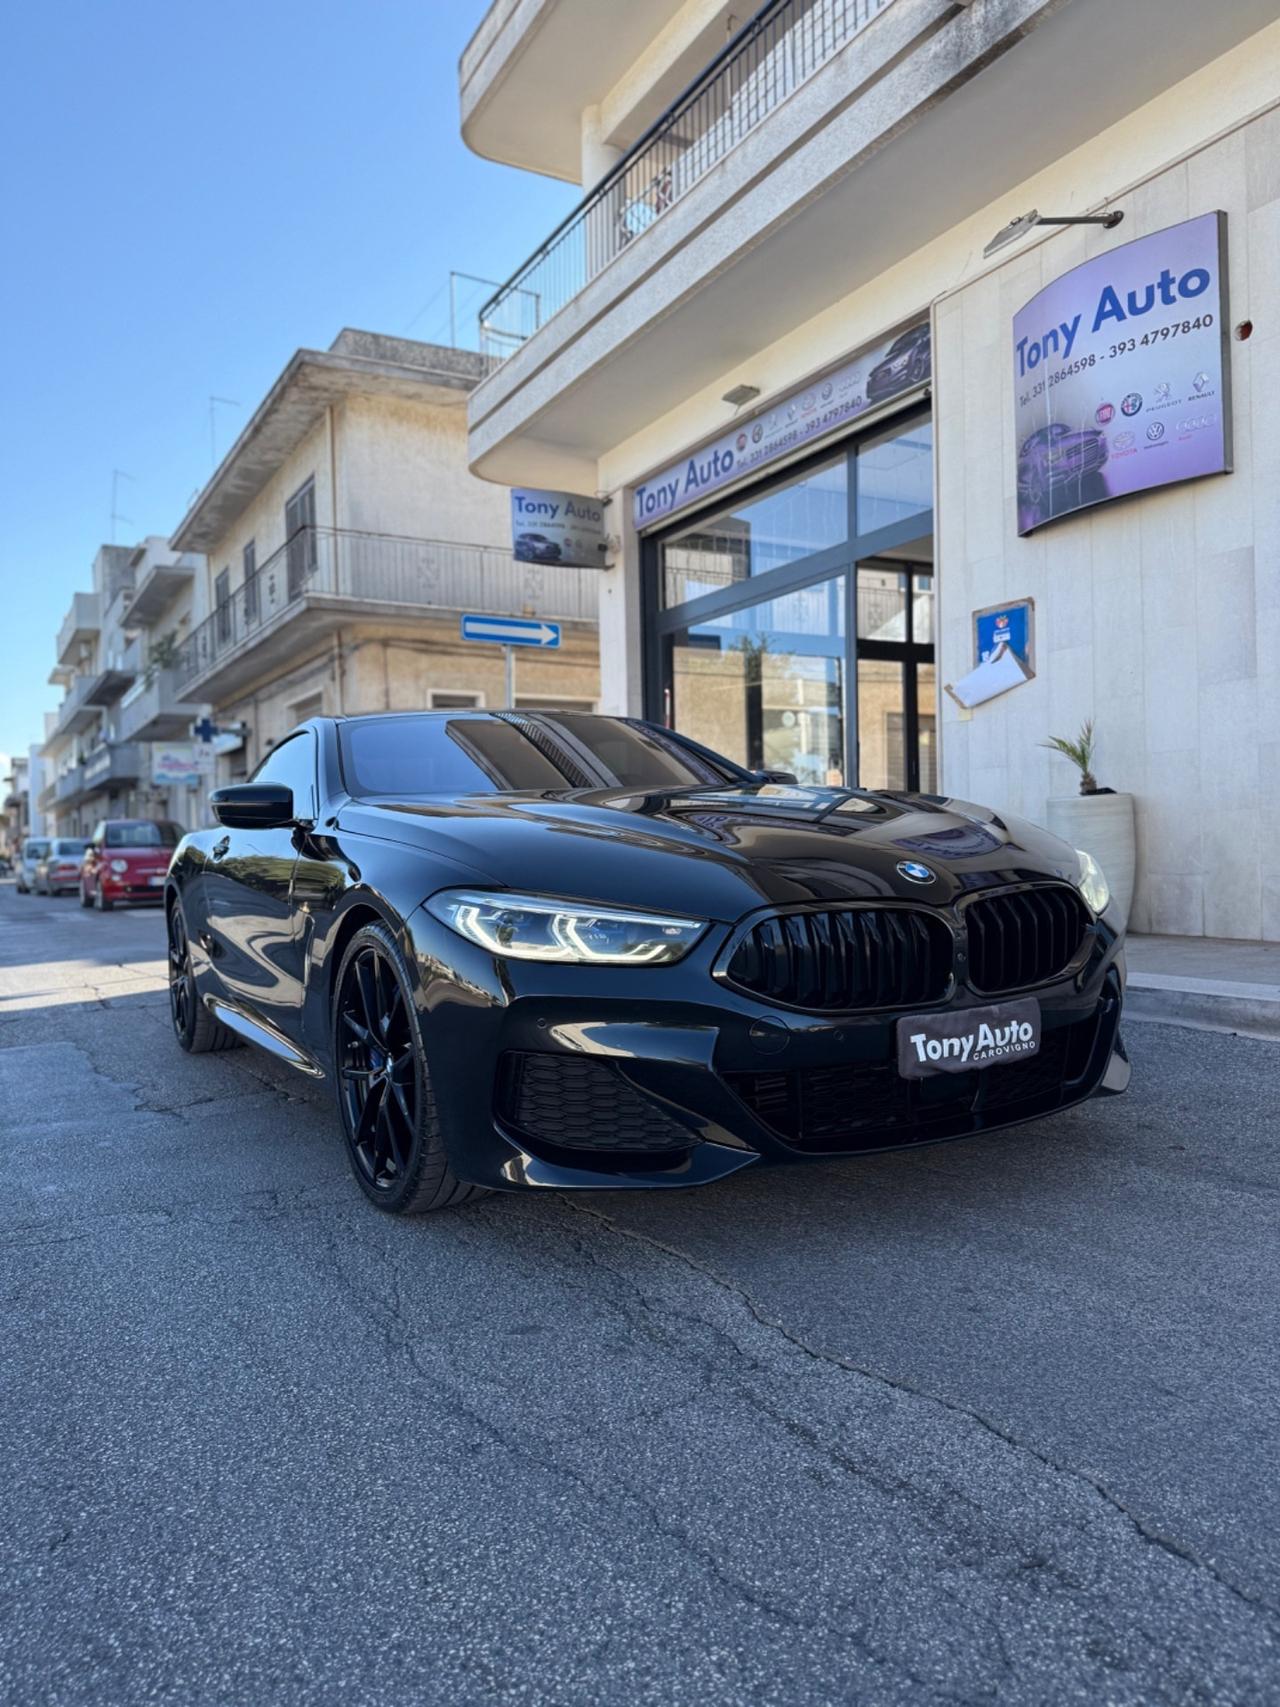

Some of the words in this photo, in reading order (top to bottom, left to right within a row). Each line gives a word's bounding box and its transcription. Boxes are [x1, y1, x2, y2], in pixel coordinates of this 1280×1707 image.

[1016, 314, 1082, 377] Tony
[1091, 268, 1211, 333] Auto
[1032, 381, 1046, 398] 331
[1047, 354, 1096, 388] 2864598
[1109, 338, 1136, 359] 393
[1140, 314, 1213, 346] 4797840
[514, 495, 560, 520] Tony
[564, 500, 602, 522] Auto
[636, 478, 680, 517] Tony
[684, 449, 734, 494] Auto
[973, 1040, 1036, 1061] CAROVIGNO
